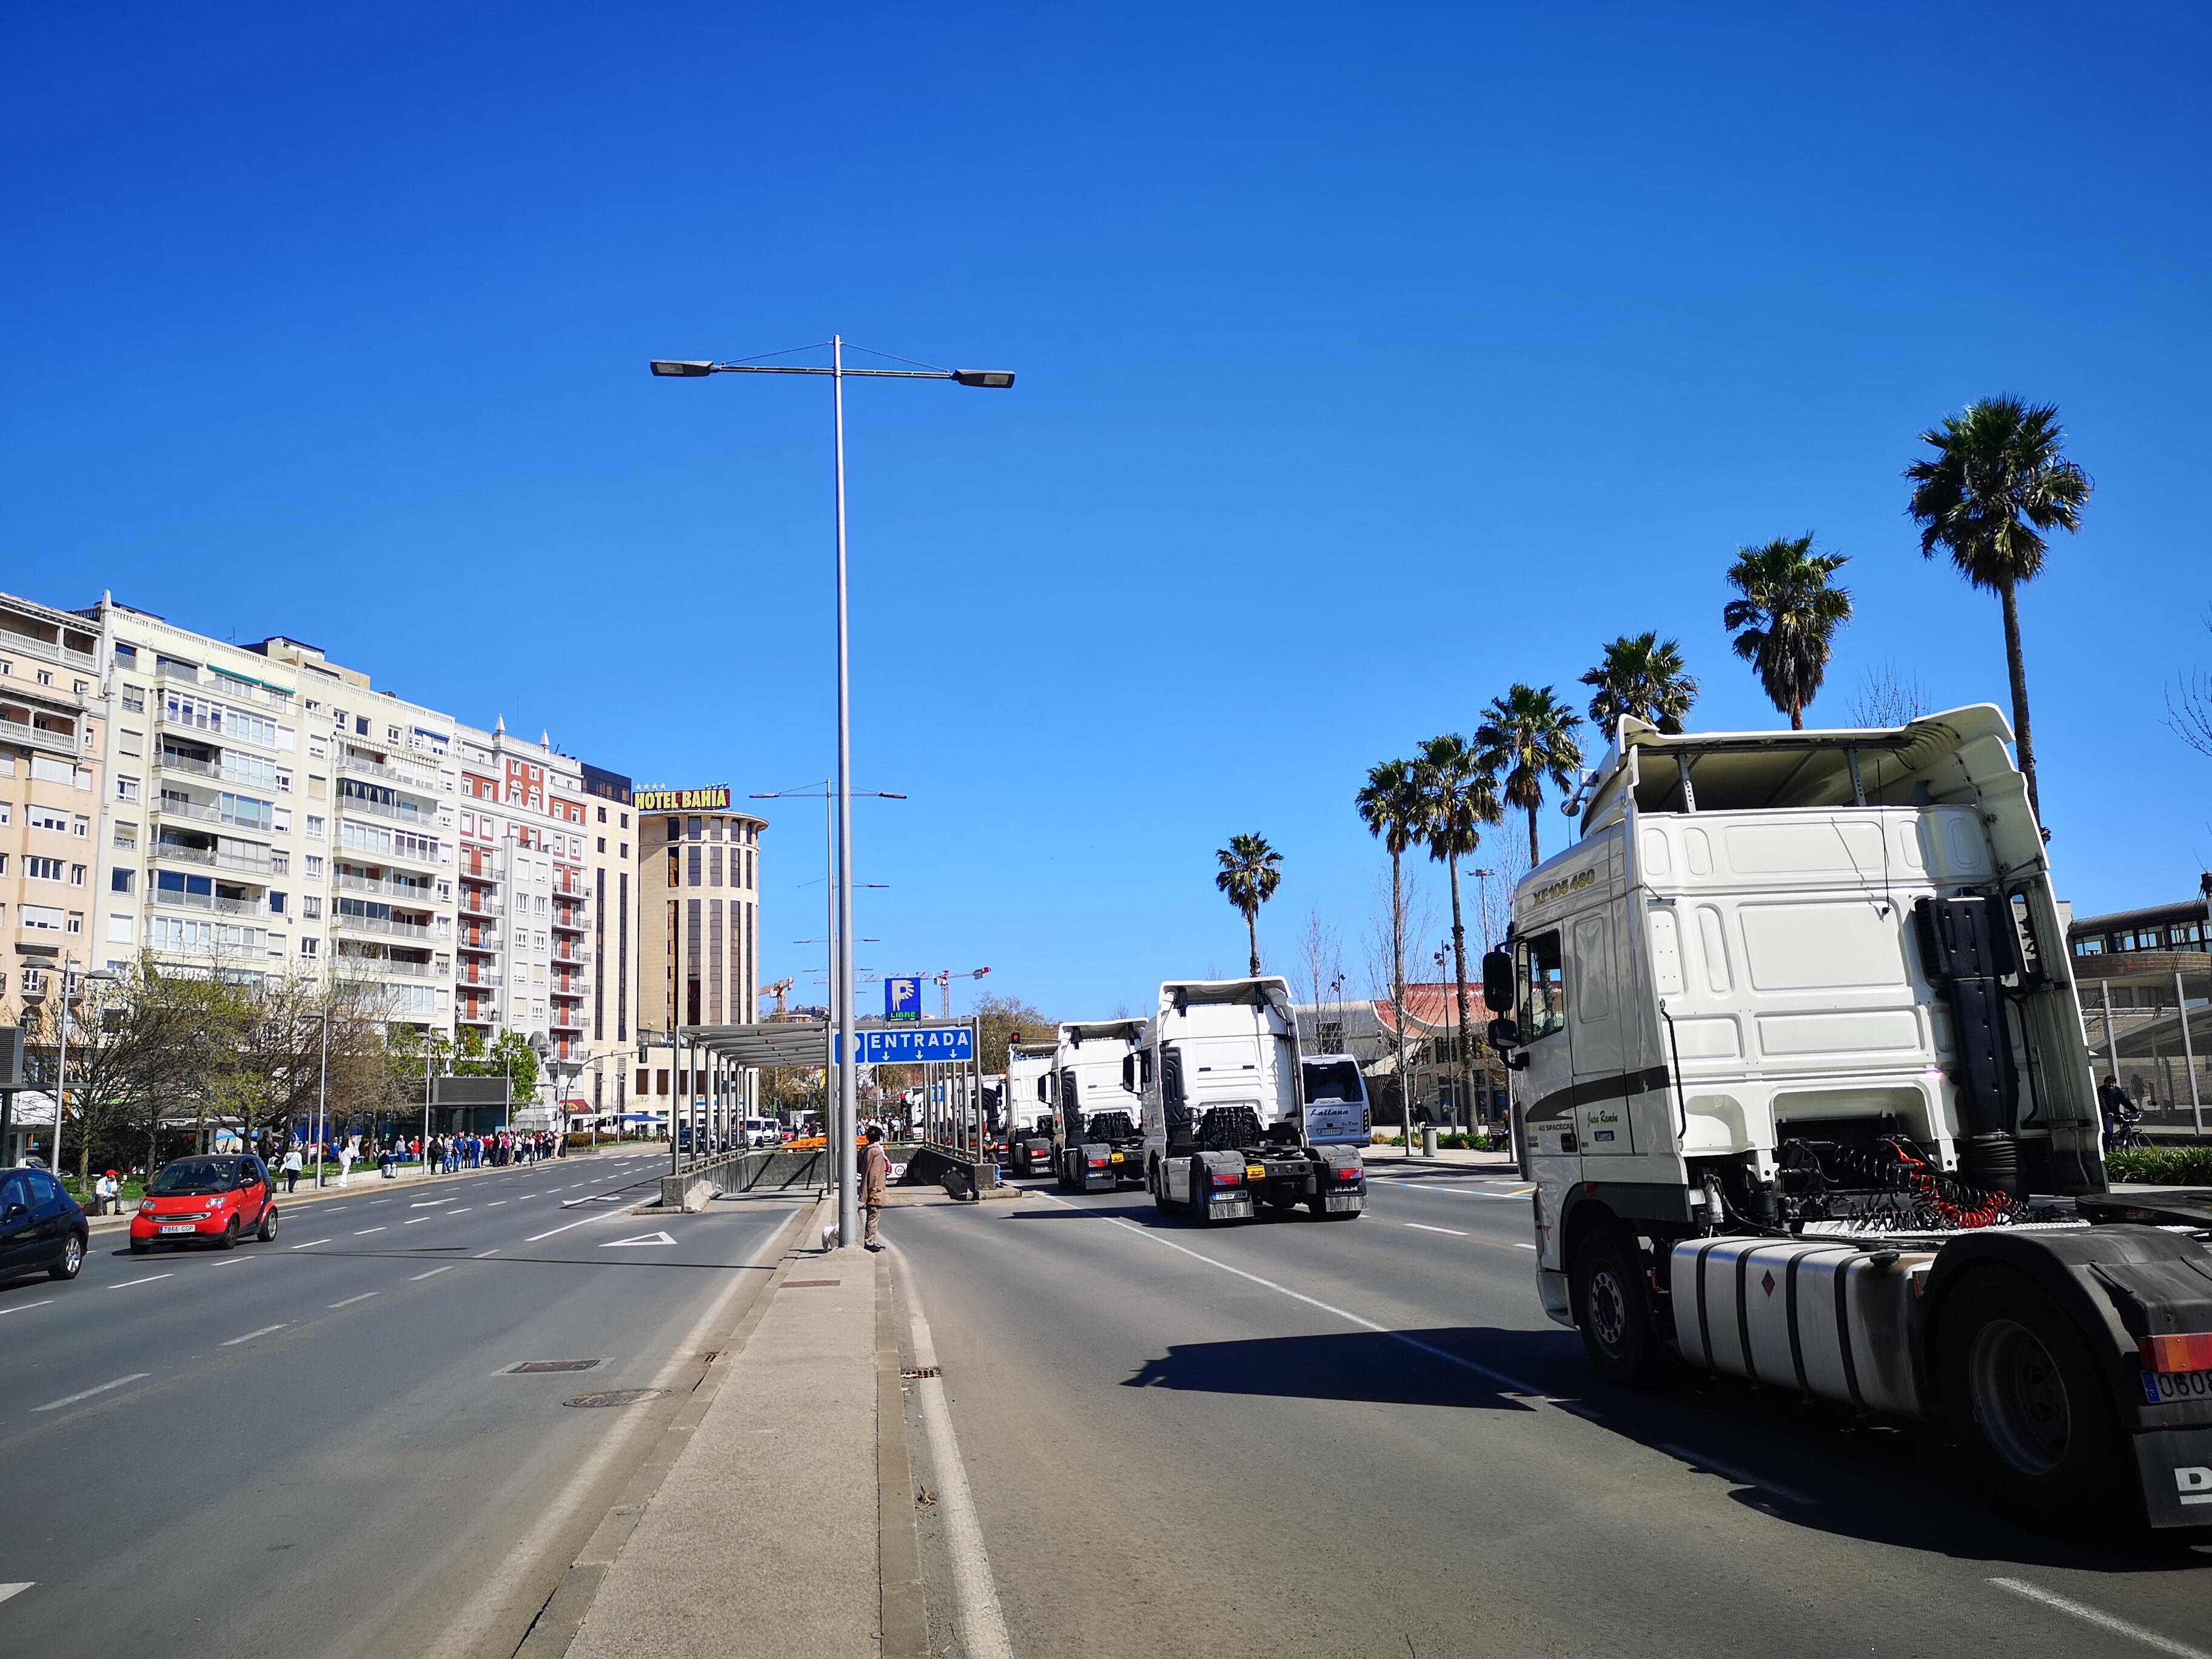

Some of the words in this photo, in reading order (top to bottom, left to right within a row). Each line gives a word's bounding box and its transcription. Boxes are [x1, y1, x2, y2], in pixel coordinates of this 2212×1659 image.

[634, 791, 679, 809] HOTEL
[871, 1031, 968, 1048] ENTRADA
[1597, 1131, 1612, 1141] Luena
